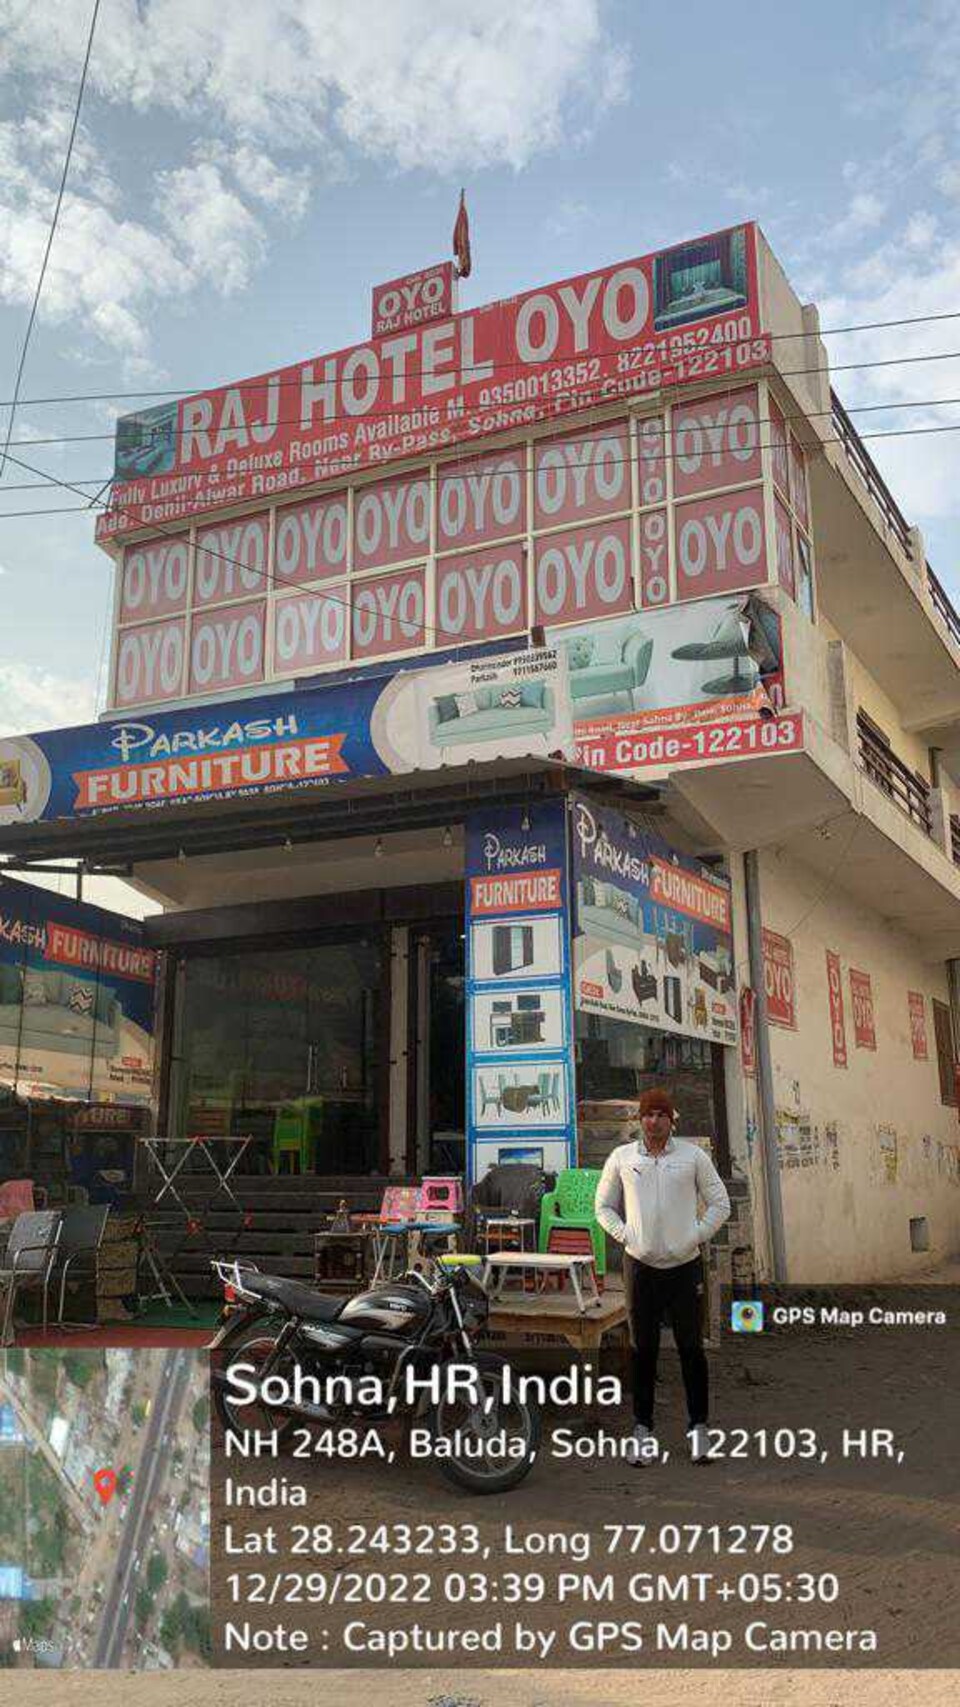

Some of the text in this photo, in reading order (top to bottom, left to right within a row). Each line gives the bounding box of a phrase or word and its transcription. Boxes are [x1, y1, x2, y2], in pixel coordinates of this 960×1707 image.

[377, 300, 446, 333] RAJ HOTEL
[378, 276, 445, 318] OYO
[181, 267, 650, 465] RAJ HOTEL OYO
[151, 474, 201, 497] Luxury
[208, 465, 220, 484] &
[227, 450, 283, 479] Deluxe
[289, 432, 349, 462] Rooms
[354, 405, 440, 445] Available
[675, 404, 758, 475] OYO
[440, 460, 521, 538] OYO
[537, 436, 624, 515] OYO
[277, 503, 347, 575] OYO
[357, 480, 431, 555] OYO
[679, 505, 763, 577] OYO
[124, 544, 187, 608] OYO
[200, 521, 265, 599] OYO
[536, 534, 626, 616] OYO
[645, 514, 667, 603] OYO
[279, 595, 345, 660] OYO
[354, 580, 424, 647] OYO
[440, 559, 521, 635] OYO
[119, 625, 182, 699] OYO
[193, 615, 263, 684] OYO
[88, 741, 330, 803] FURNITURE
[616, 720, 795, 764] Code-122103
[475, 876, 558, 908] FURNITURE
[651, 864, 727, 925] FURNITURE
[52, 930, 151, 974] FURNITURE
[763, 959, 792, 1003] OYO
